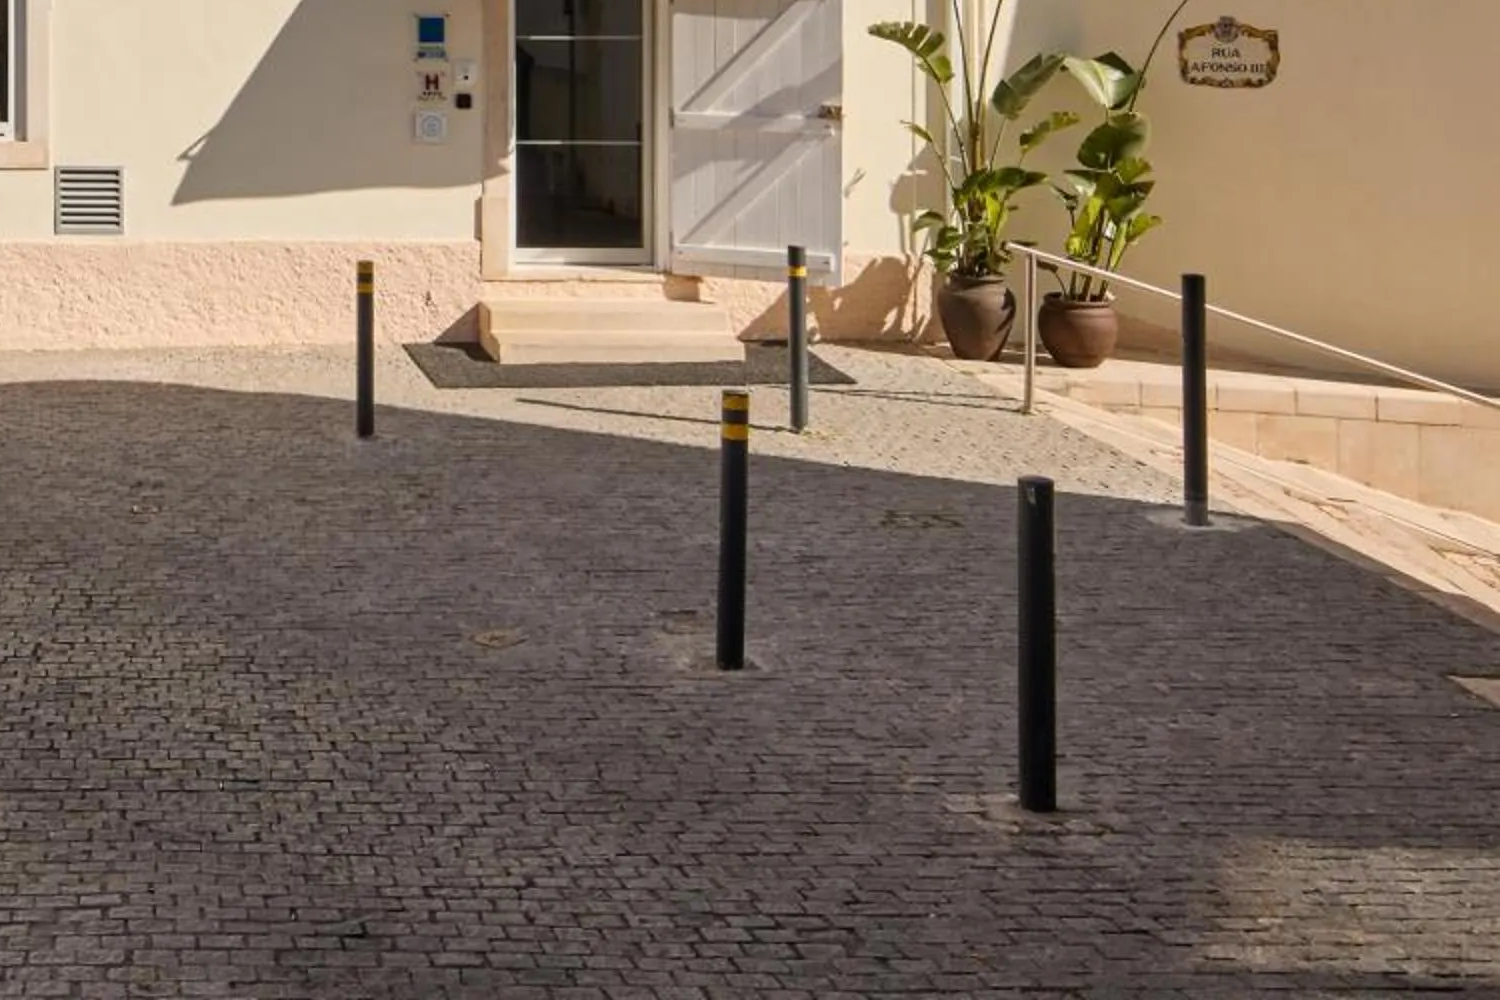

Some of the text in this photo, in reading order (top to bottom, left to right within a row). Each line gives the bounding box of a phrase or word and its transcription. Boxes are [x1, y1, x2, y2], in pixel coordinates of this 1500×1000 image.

[1211, 47, 1240, 59] RUA
[1191, 62, 1248, 73] AFONSO
[425, 74, 440, 91] H
